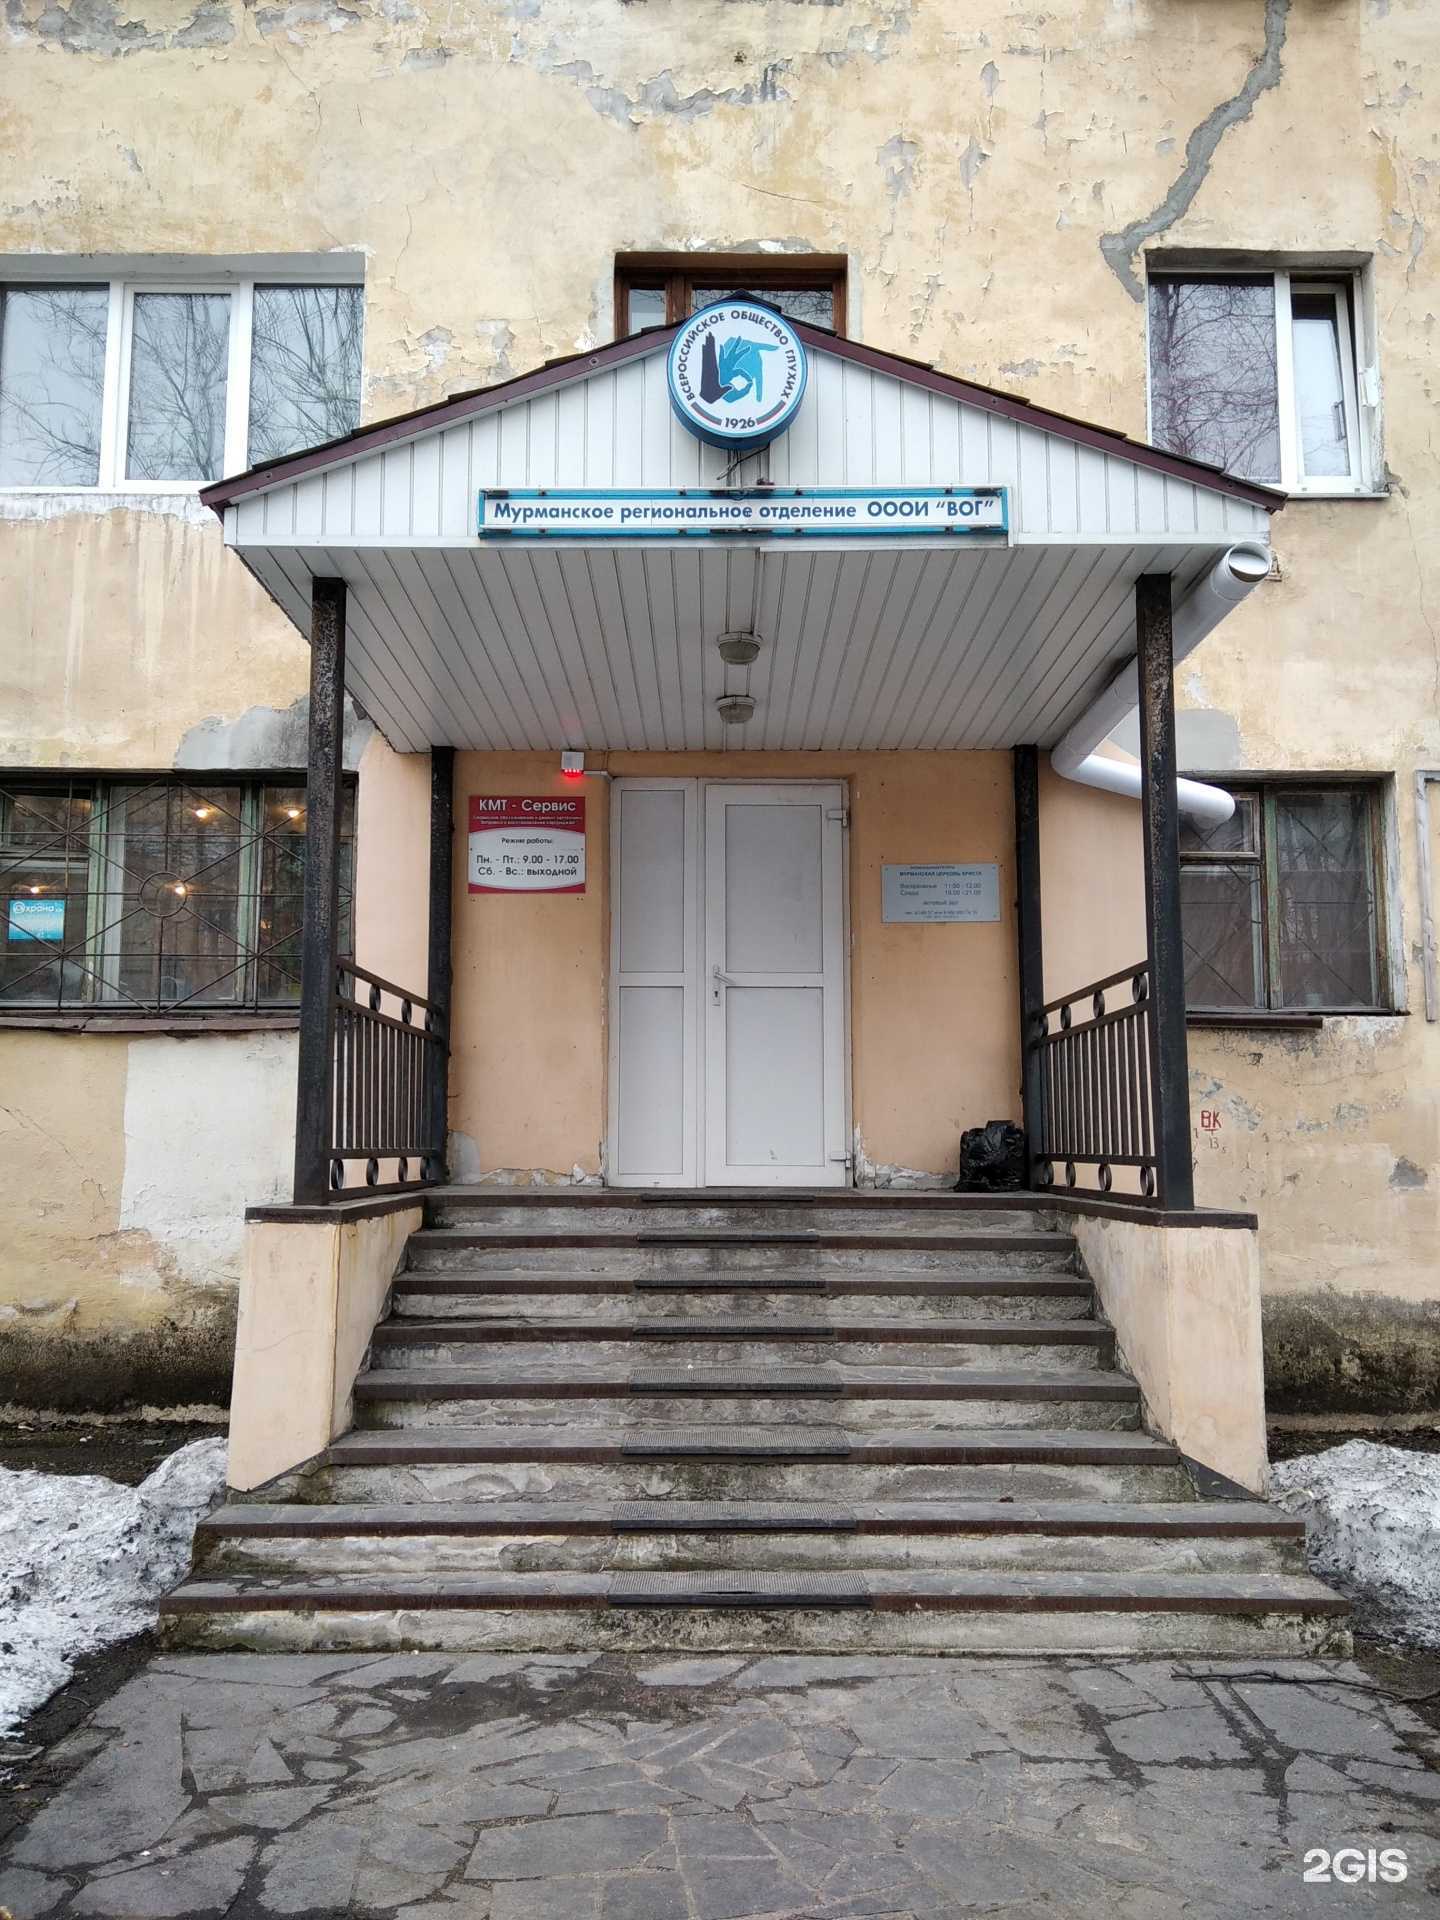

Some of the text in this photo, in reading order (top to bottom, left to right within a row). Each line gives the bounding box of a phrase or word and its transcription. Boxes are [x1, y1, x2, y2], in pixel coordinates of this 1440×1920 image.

[678, 310, 797, 402] ВСЕРОССИЙСКОЕ ОБЩЕСТВО ГЛУХИХ
[725, 417, 756, 429] 1926
[494, 503, 614, 523] Мурманское
[620, 505, 752, 523] региональное
[759, 504, 857, 520] отделение
[867, 501, 929, 517] ОООИ
[479, 799, 507, 811] КМТ
[521, 799, 576, 813] Сервис
[523, 855, 543, 864] 9.00
[554, 855, 579, 864] 17.00
[527, 865, 577, 877] выходной
